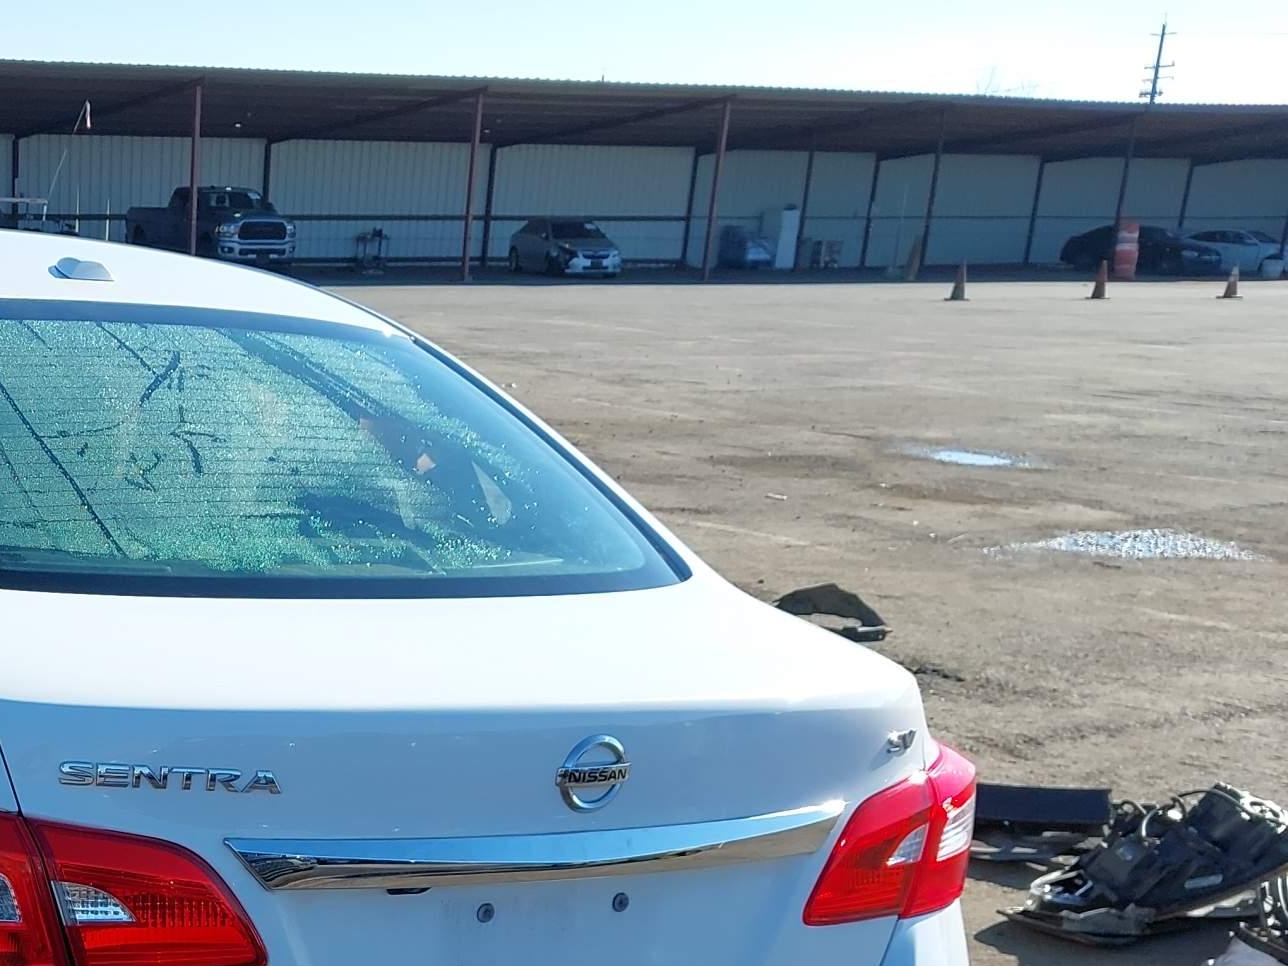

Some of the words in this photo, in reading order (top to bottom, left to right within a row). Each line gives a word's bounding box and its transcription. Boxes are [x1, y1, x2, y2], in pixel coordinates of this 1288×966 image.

[887, 728, 916, 755] SV
[58, 760, 282, 795] SENTRA
[568, 768, 627, 784] NISSAN
